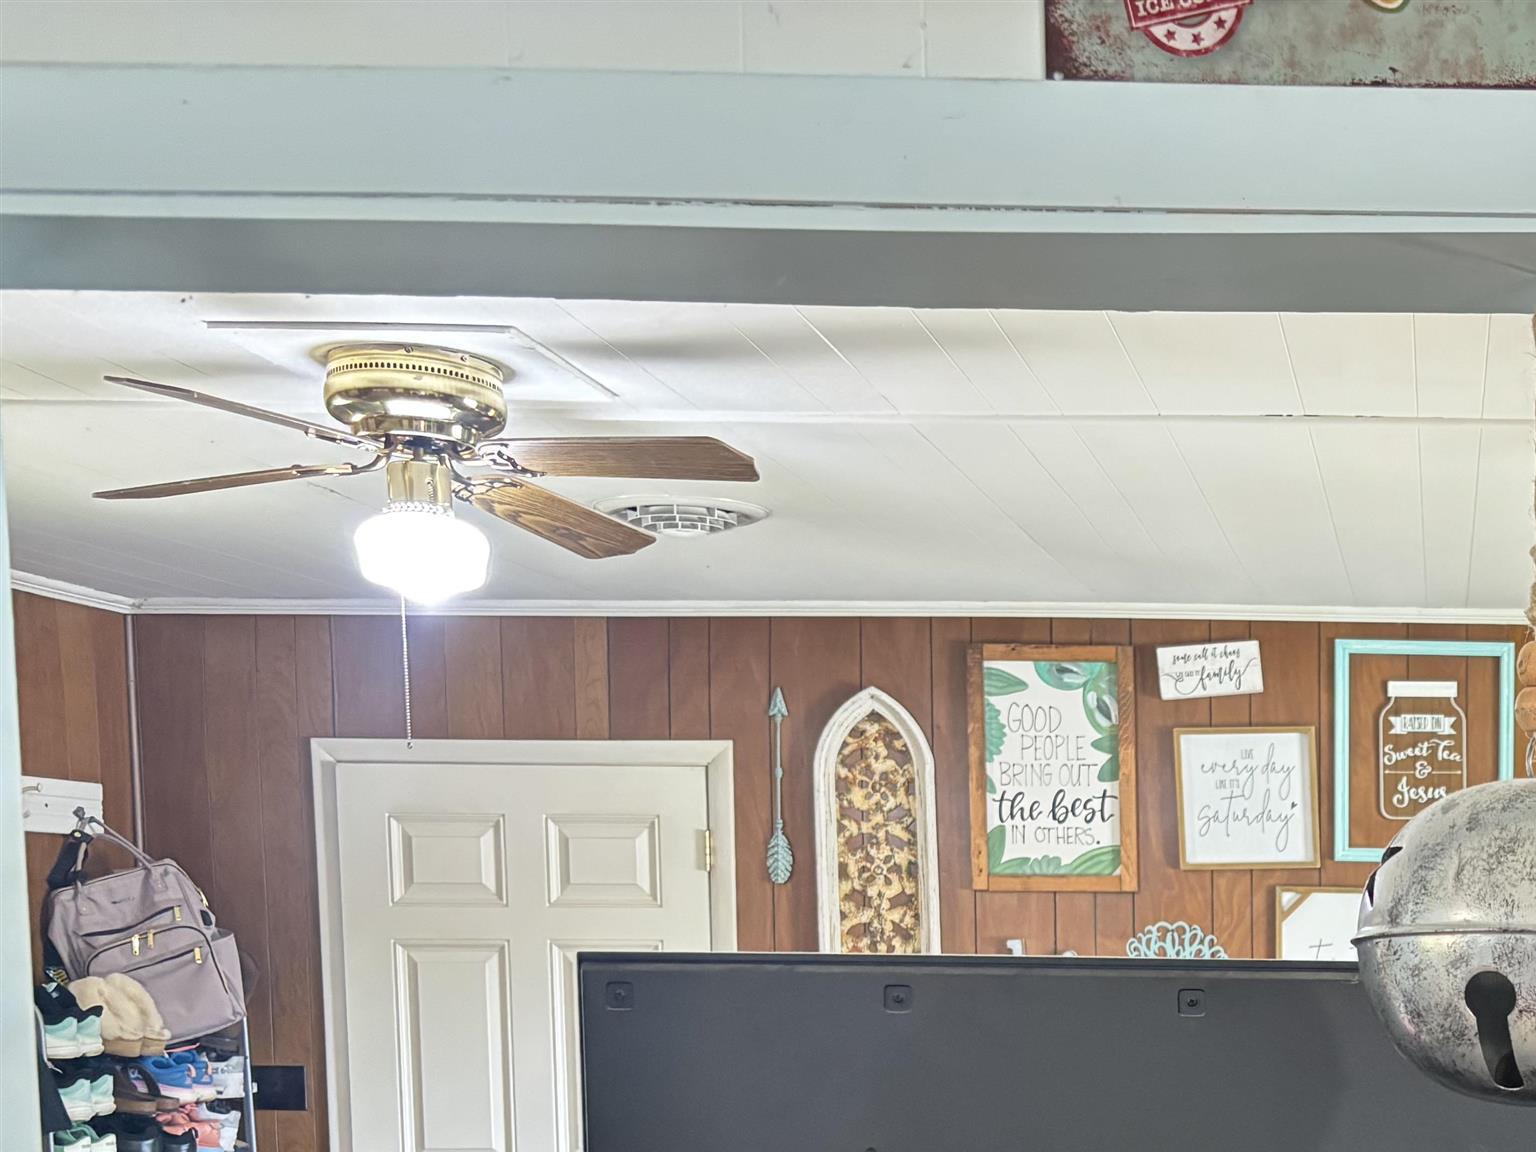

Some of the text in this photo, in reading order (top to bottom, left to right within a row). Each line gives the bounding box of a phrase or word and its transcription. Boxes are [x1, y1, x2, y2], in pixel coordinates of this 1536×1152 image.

[1136, 0, 1175, 17] ICE
[1007, 702, 1062, 734] GOOD
[1020, 735, 1087, 762] PEOPLE
[1384, 738, 1464, 766] Sweet Tea
[999, 762, 1099, 787] BRING OUT
[1200, 742, 1296, 801] every day
[1414, 760, 1432, 779] &
[1392, 775, 1447, 808] Jesus
[992, 788, 1118, 825] the best
[1011, 826, 1026, 845] IN
